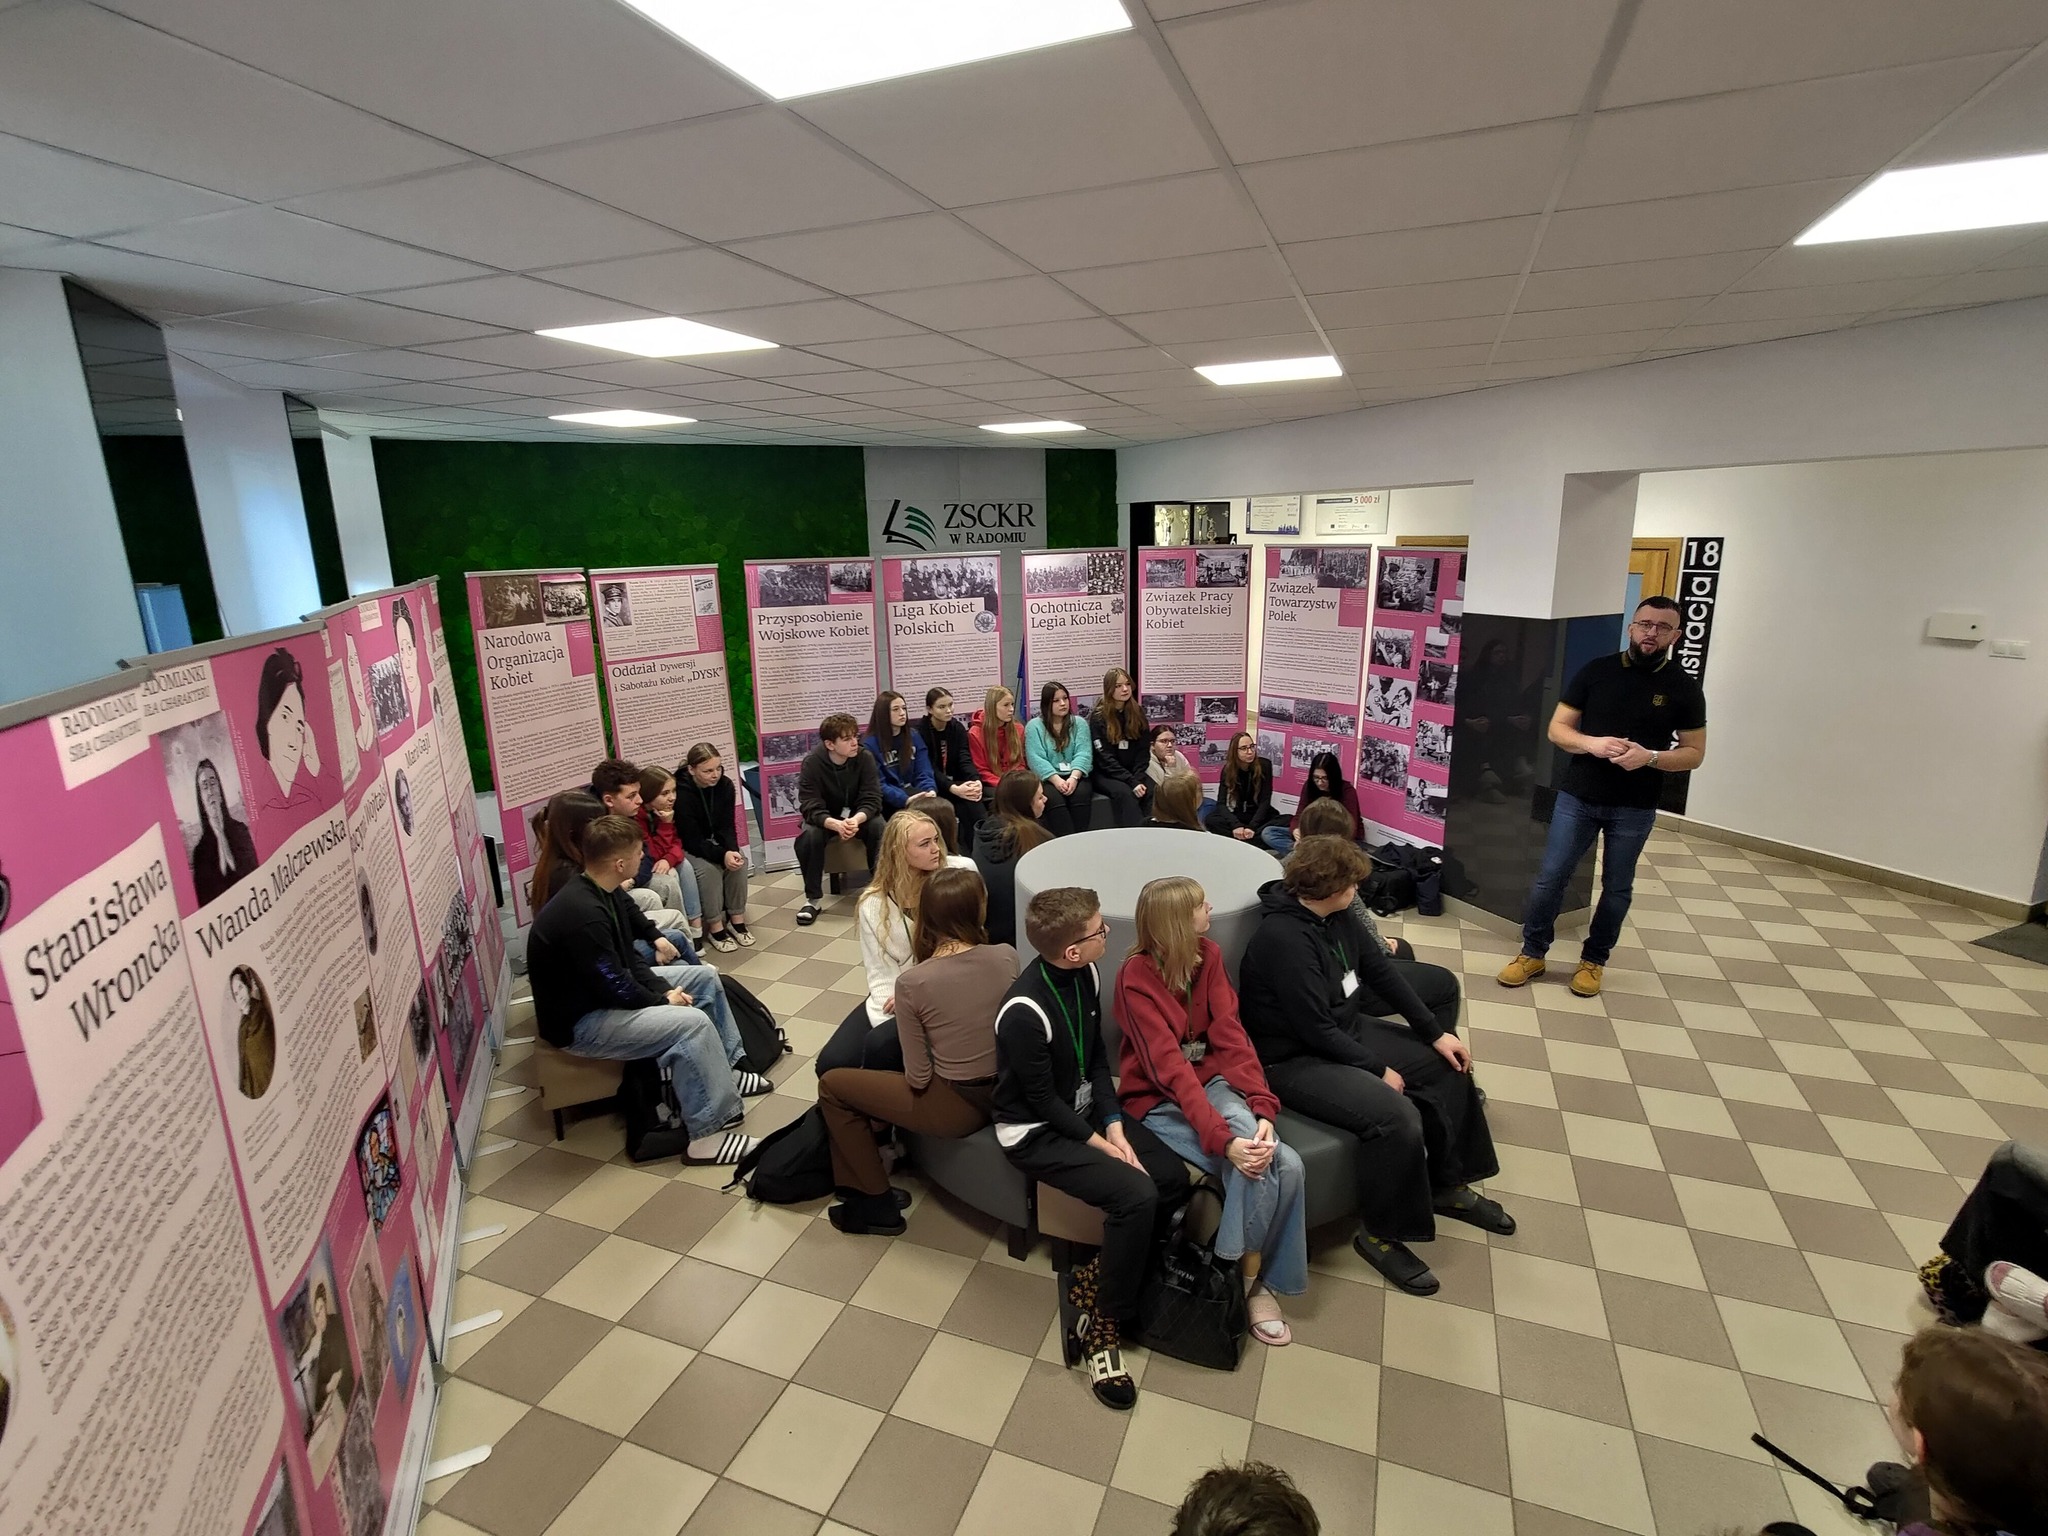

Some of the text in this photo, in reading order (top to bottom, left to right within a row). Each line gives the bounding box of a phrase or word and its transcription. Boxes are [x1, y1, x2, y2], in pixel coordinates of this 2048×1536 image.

[1354, 496, 1359, 504] 5
[1360, 495, 1373, 504] 000
[1374, 495, 1380, 504] zł
[944, 503, 1036, 529] ZSCKR
[966, 532, 1026, 544] RADOMIU
[1688, 540, 1720, 568] 18
[1145, 591, 1234, 604] Związek Pracy
[1269, 582, 1316, 596] Związek
[893, 601, 976, 620] Liga Kobiet
[1030, 600, 1103, 614] Ochotnicza
[1145, 604, 1232, 618] Obywatelskiej
[1269, 596, 1337, 611] Towarzystw
[758, 610, 863, 627] Przysposobienie
[1031, 612, 1111, 630] Legia Kobiet
[1145, 618, 1185, 629] Kobiet
[1268, 610, 1297, 622] Polek
[758, 625, 870, 643] Wojskowe Kobiet
[893, 620, 955, 636] Polskich
[484, 631, 552, 650] Narodowa
[487, 646, 565, 671] Organizacja
[612, 659, 696, 678] Oddział Dywersji
[490, 671, 534, 690] Kobiet
[620, 678, 658, 692] Sabotażu
[660, 675, 685, 686] Kobiet
[195, 886, 273, 960] Wanda
[270, 818, 347, 904] Malczewska
[24, 858, 168, 1002] Stanisława
[69, 919, 181, 1043] Wroncka
